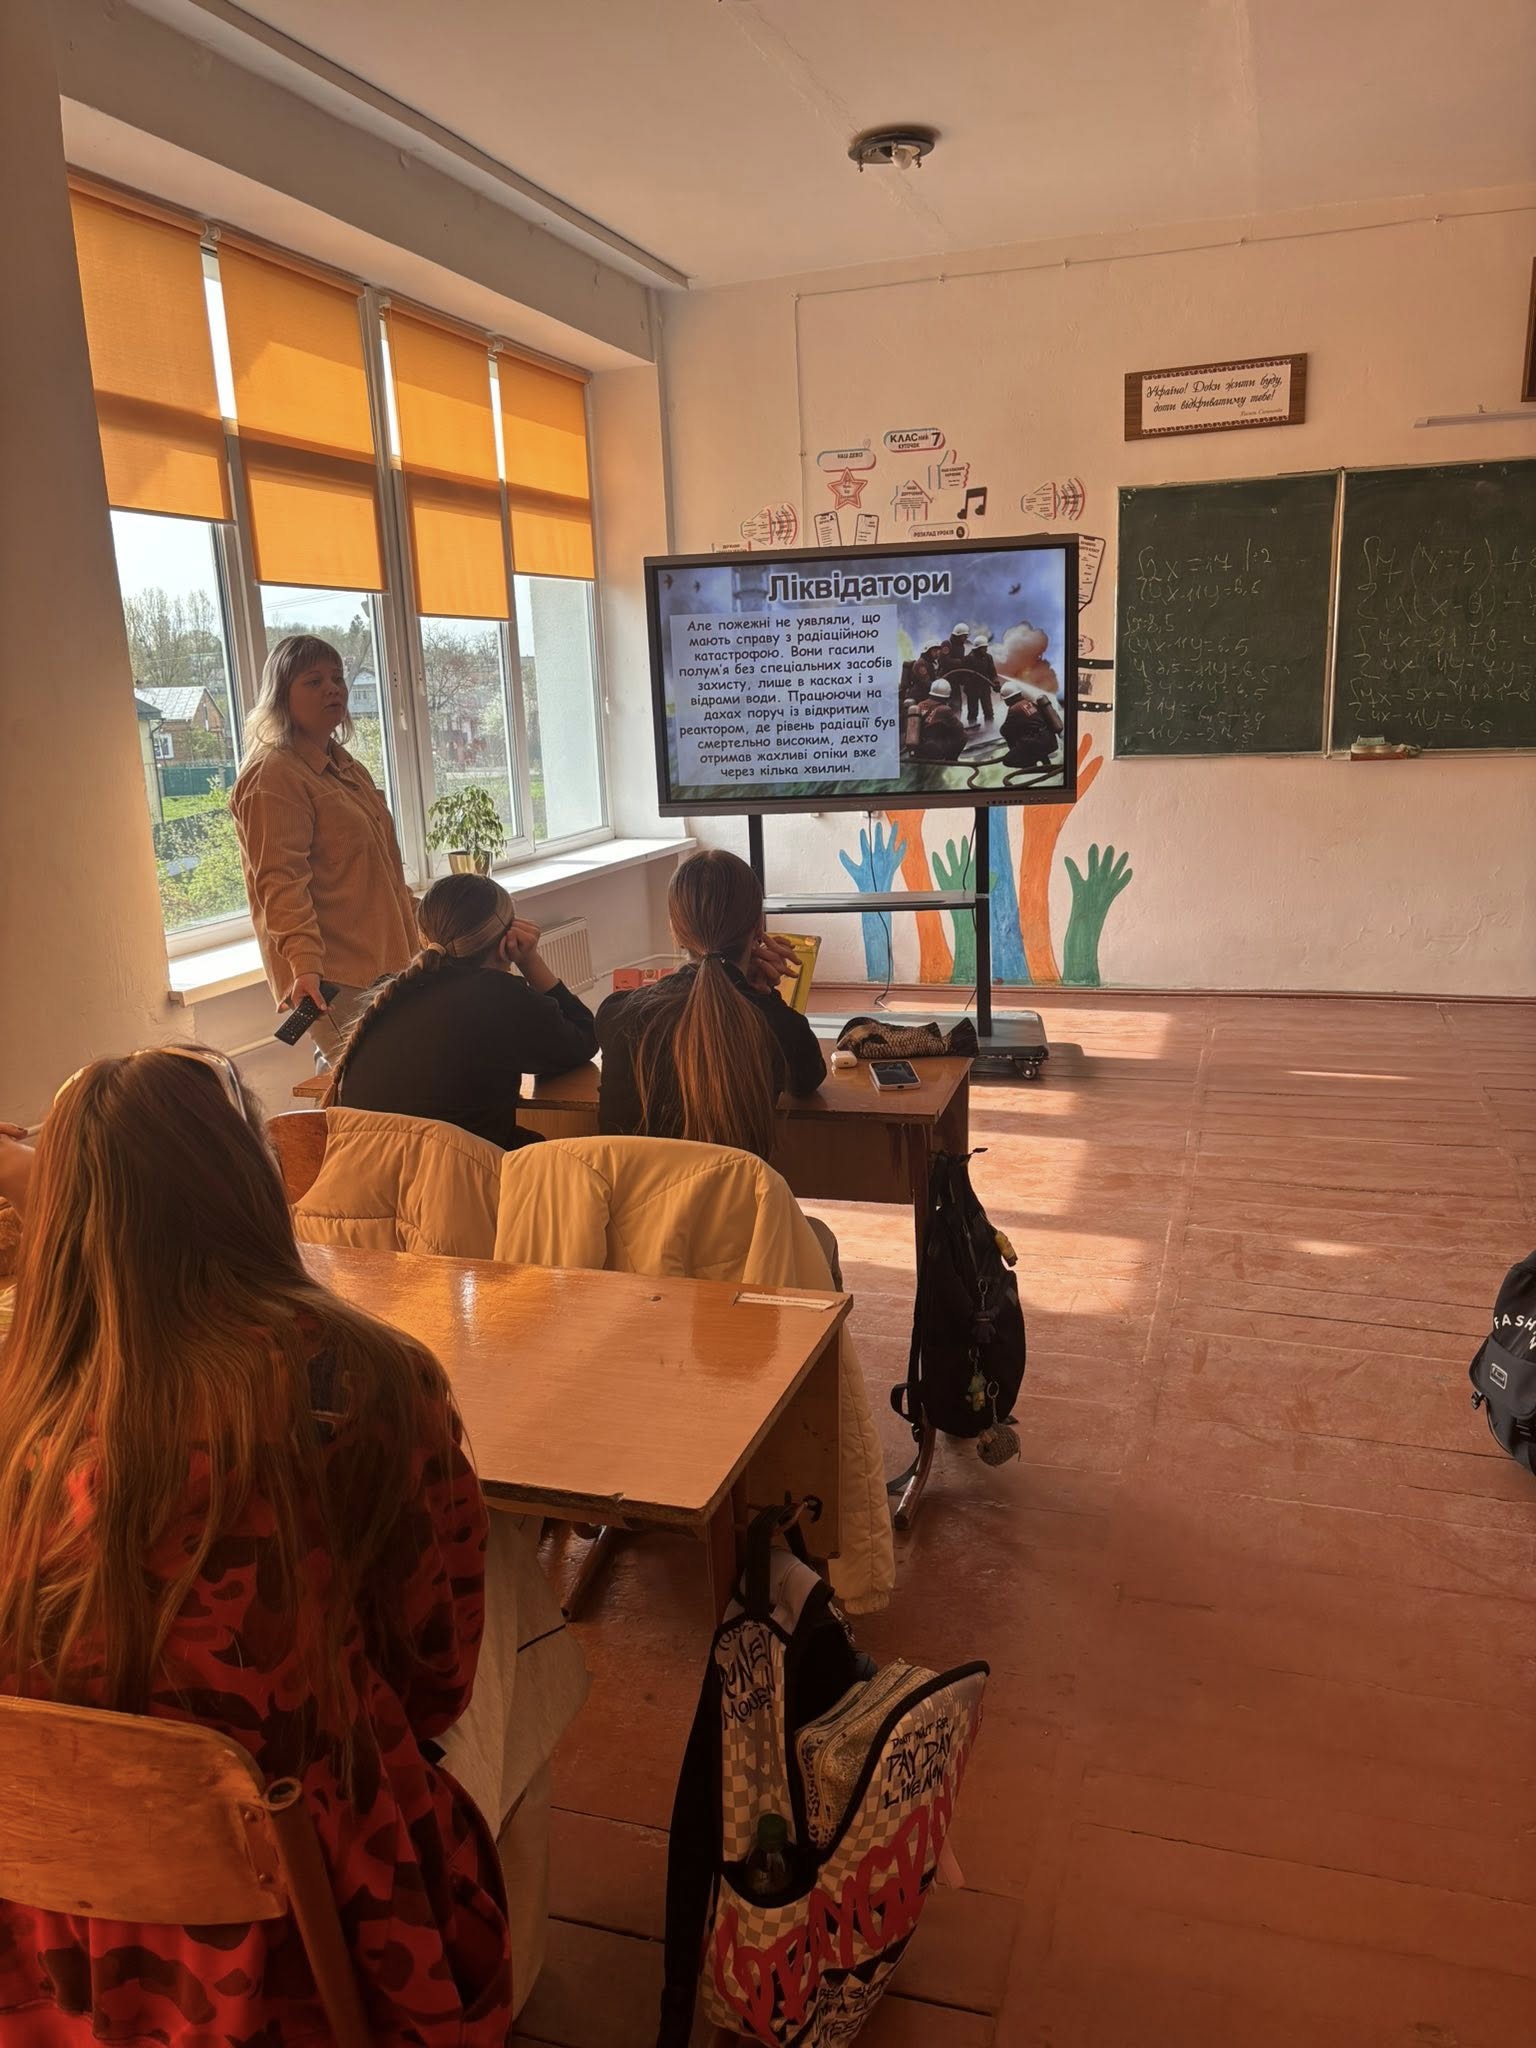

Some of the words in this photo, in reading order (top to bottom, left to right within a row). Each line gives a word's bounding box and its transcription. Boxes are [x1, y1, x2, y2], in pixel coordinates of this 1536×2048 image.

[1146, 382, 1188, 400] Україно!
[1192, 379, 1221, 394] Доки
[1225, 377, 1256, 391] жити
[1259, 373, 1282, 387] буду,
[1153, 402, 1177, 413] доти
[1180, 396, 1247, 412] відкриватиму
[1250, 390, 1275, 403] тебе!
[931, 432, 941, 446] 7
[913, 530, 936, 538] РОЗКЛАД
[769, 573, 950, 602] Ліквідатори
[687, 621, 712, 631] Але
[718, 617, 770, 630] пожежні
[776, 618, 791, 628] не
[797, 617, 854, 630] уявляли,
[862, 614, 880, 626] що
[689, 638, 731, 646] мають
[736, 635, 780, 647] справу
[785, 634, 792, 642] з
[797, 628, 879, 645] радіаційною
[694, 650, 784, 662] катастрофою.
[791, 646, 823, 657] Вони
[828, 644, 875, 655] гасили
[679, 664, 729, 679] полум'я
[735, 663, 755, 674] без
[760, 661, 841, 673] спеціальних
[846, 656, 893, 669] засобів
[697, 681, 751, 693] захисту,
[758, 679, 792, 688] лише
[810, 675, 853, 686] касках
[858, 673, 862, 684] і
[867, 675, 874, 684] з
[691, 695, 740, 708] відрами
[746, 694, 781, 704] води.
[788, 690, 861, 704] Працюючи
[867, 689, 882, 698] на
[704, 711, 741, 721] дахах
[747, 709, 784, 721] поруч
[790, 706, 799, 716] із
[805, 705, 870, 718] відкритим
[680, 725, 749, 738] реактором,
[756, 724, 771, 734] де
[776, 721, 815, 734] рівень
[820, 717, 869, 733] радіації
[874, 717, 896, 730] був
[697, 739, 771, 751] смертельно
[776, 737, 834, 746] високим,
[841, 734, 878, 745] дехто
[700, 753, 752, 766] отримав
[757, 749, 808, 761] жахливі
[813, 748, 848, 759] опіки
[853, 748, 876, 758] вже
[721, 768, 755, 779] через
[760, 765, 799, 776] кілька
[804, 765, 855, 774] хвилин.
[1494, 1313, 1536, 1335] FASH
[886, 1744, 920, 1783] PAY
[922, 1727, 955, 1768] DAY
